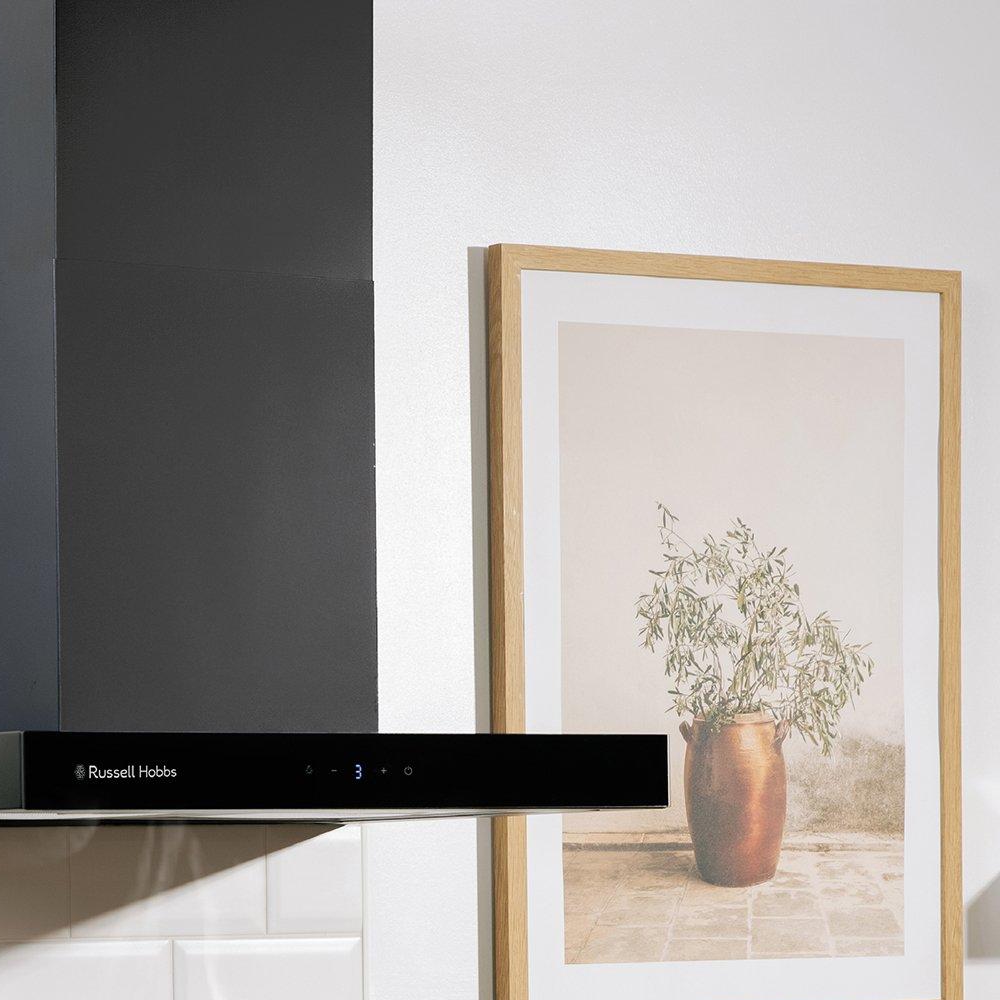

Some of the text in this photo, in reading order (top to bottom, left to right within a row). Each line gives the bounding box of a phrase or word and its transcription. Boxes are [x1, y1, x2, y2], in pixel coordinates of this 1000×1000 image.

[88, 765, 177, 779] Russell Hobbs
[355, 764, 362, 780] 3
